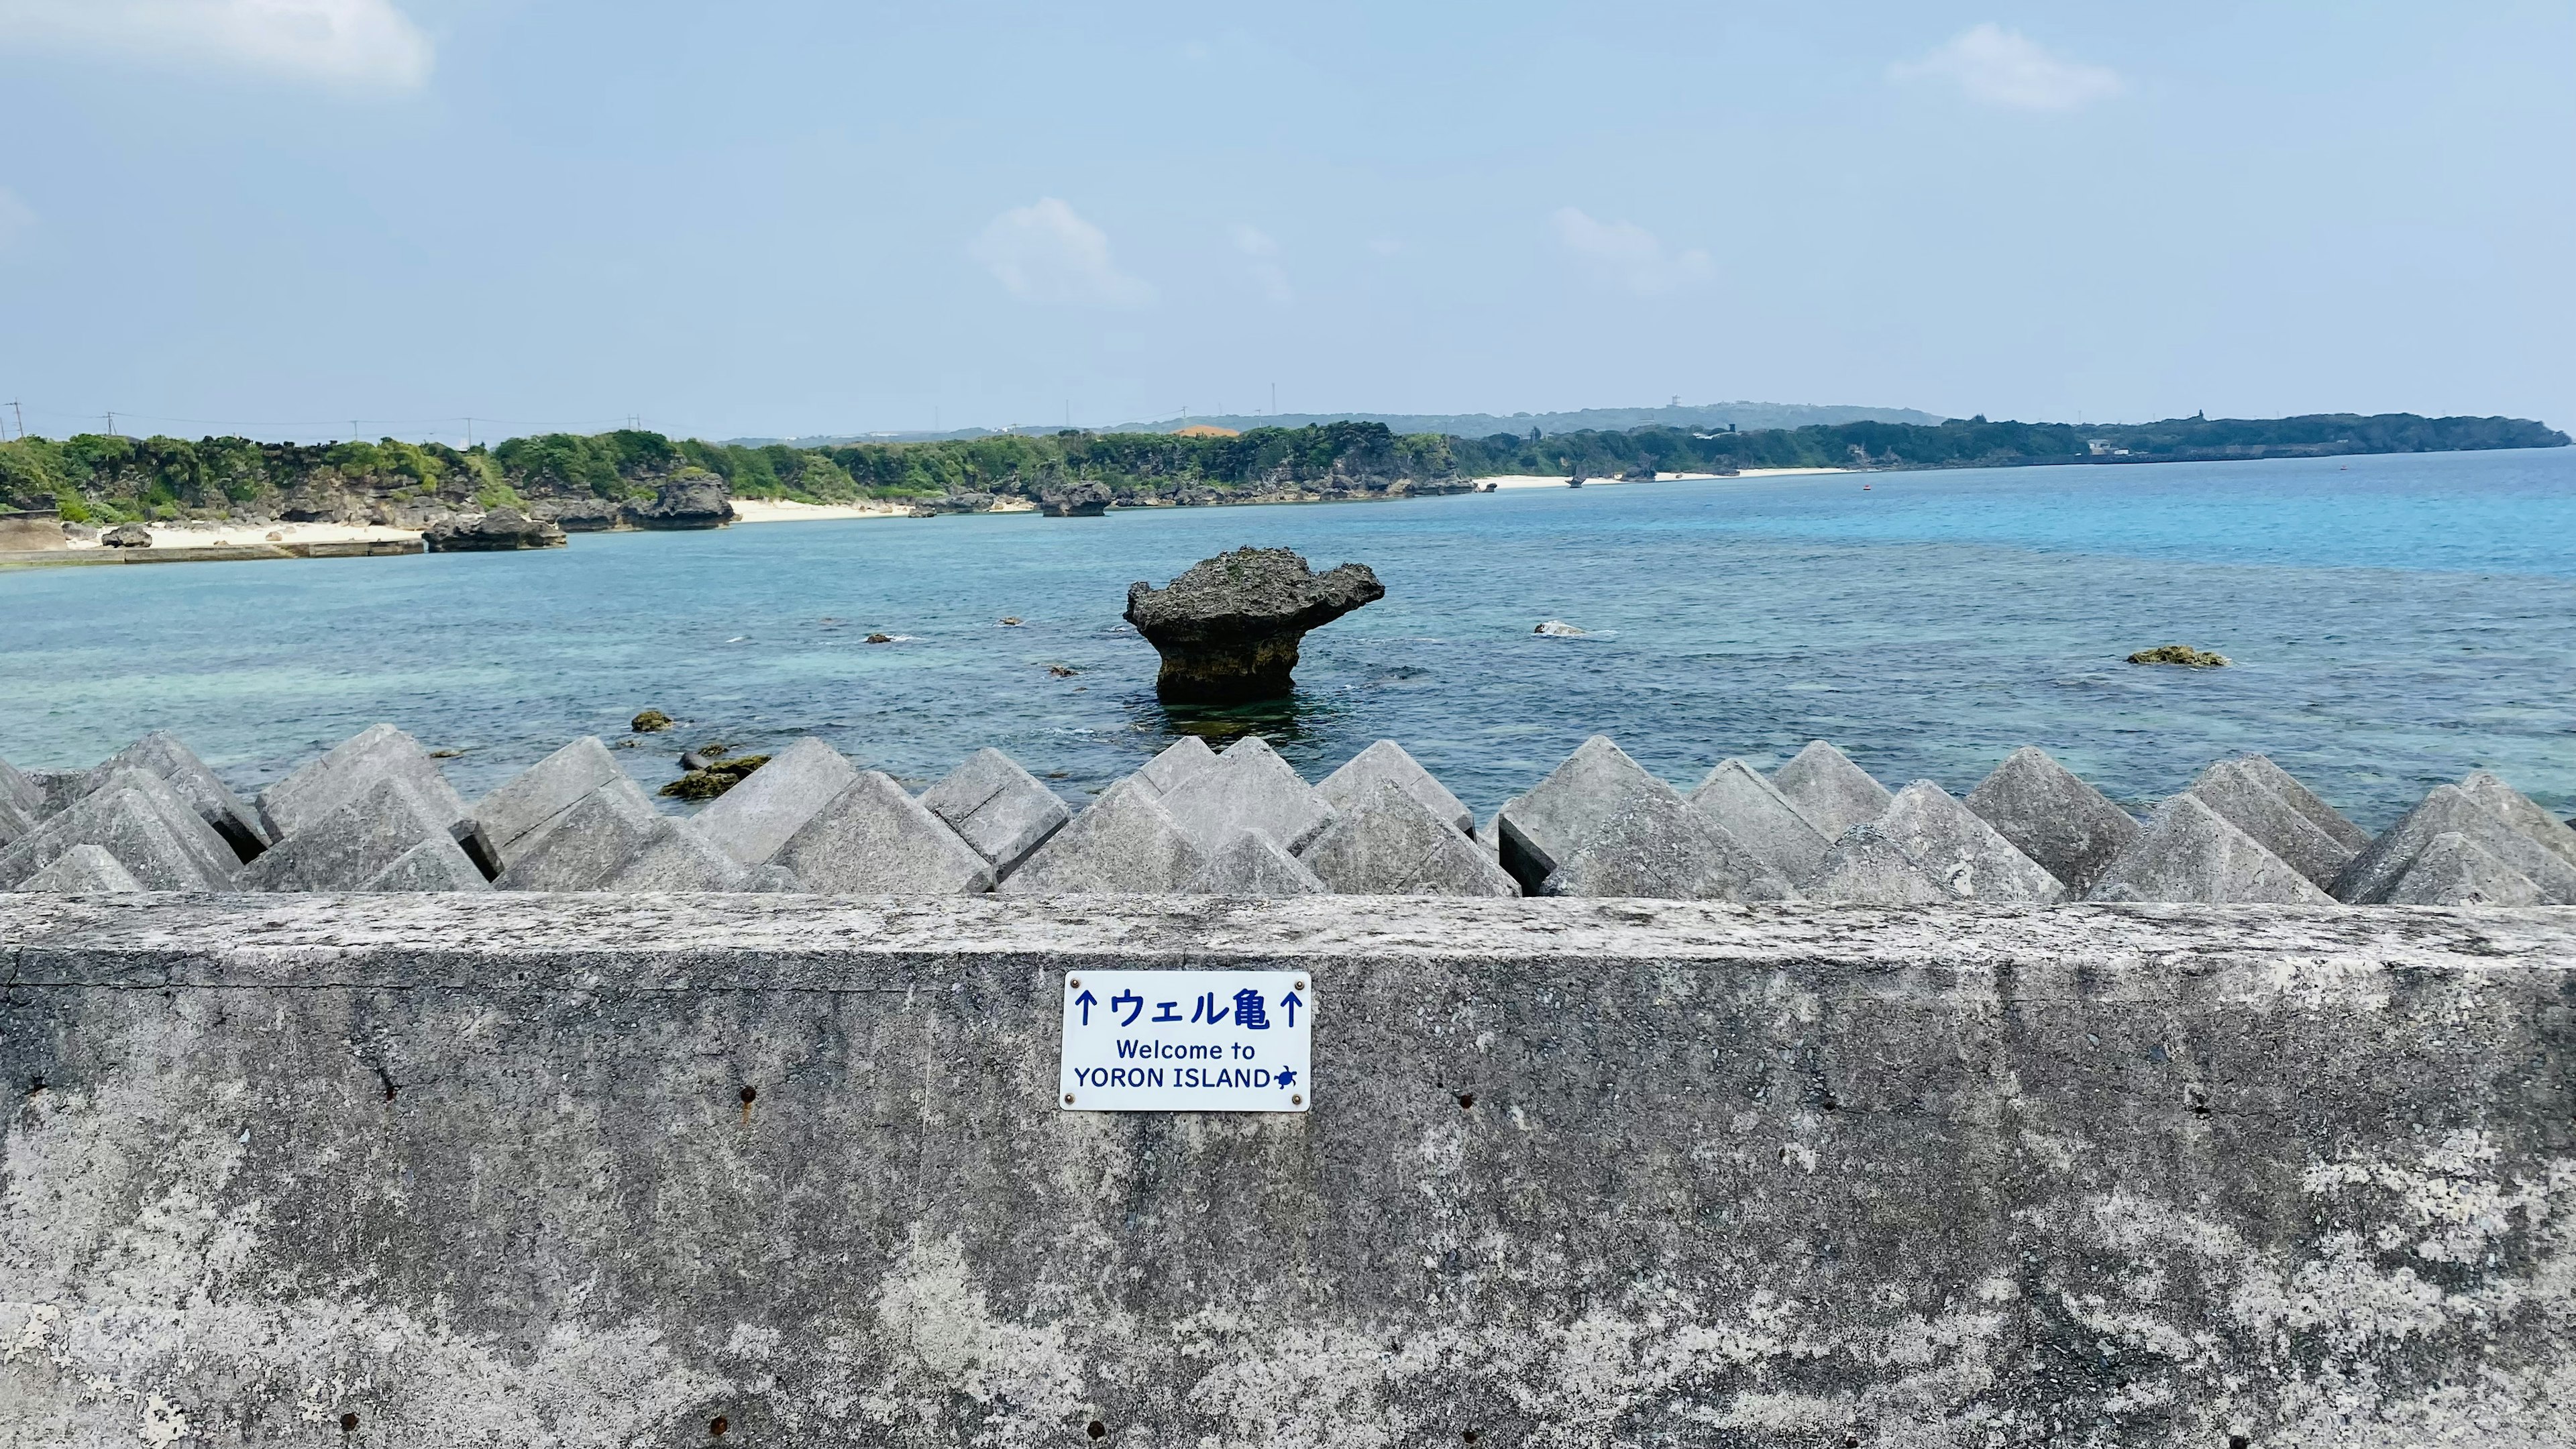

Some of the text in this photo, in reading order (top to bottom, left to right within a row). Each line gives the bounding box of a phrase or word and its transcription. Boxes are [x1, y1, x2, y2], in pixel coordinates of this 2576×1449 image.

[1111, 987, 1271, 1030] ウェル亀
[1116, 1039, 1255, 1060] Welcome to
[1074, 1067, 1271, 1088] YORON ISLAND
